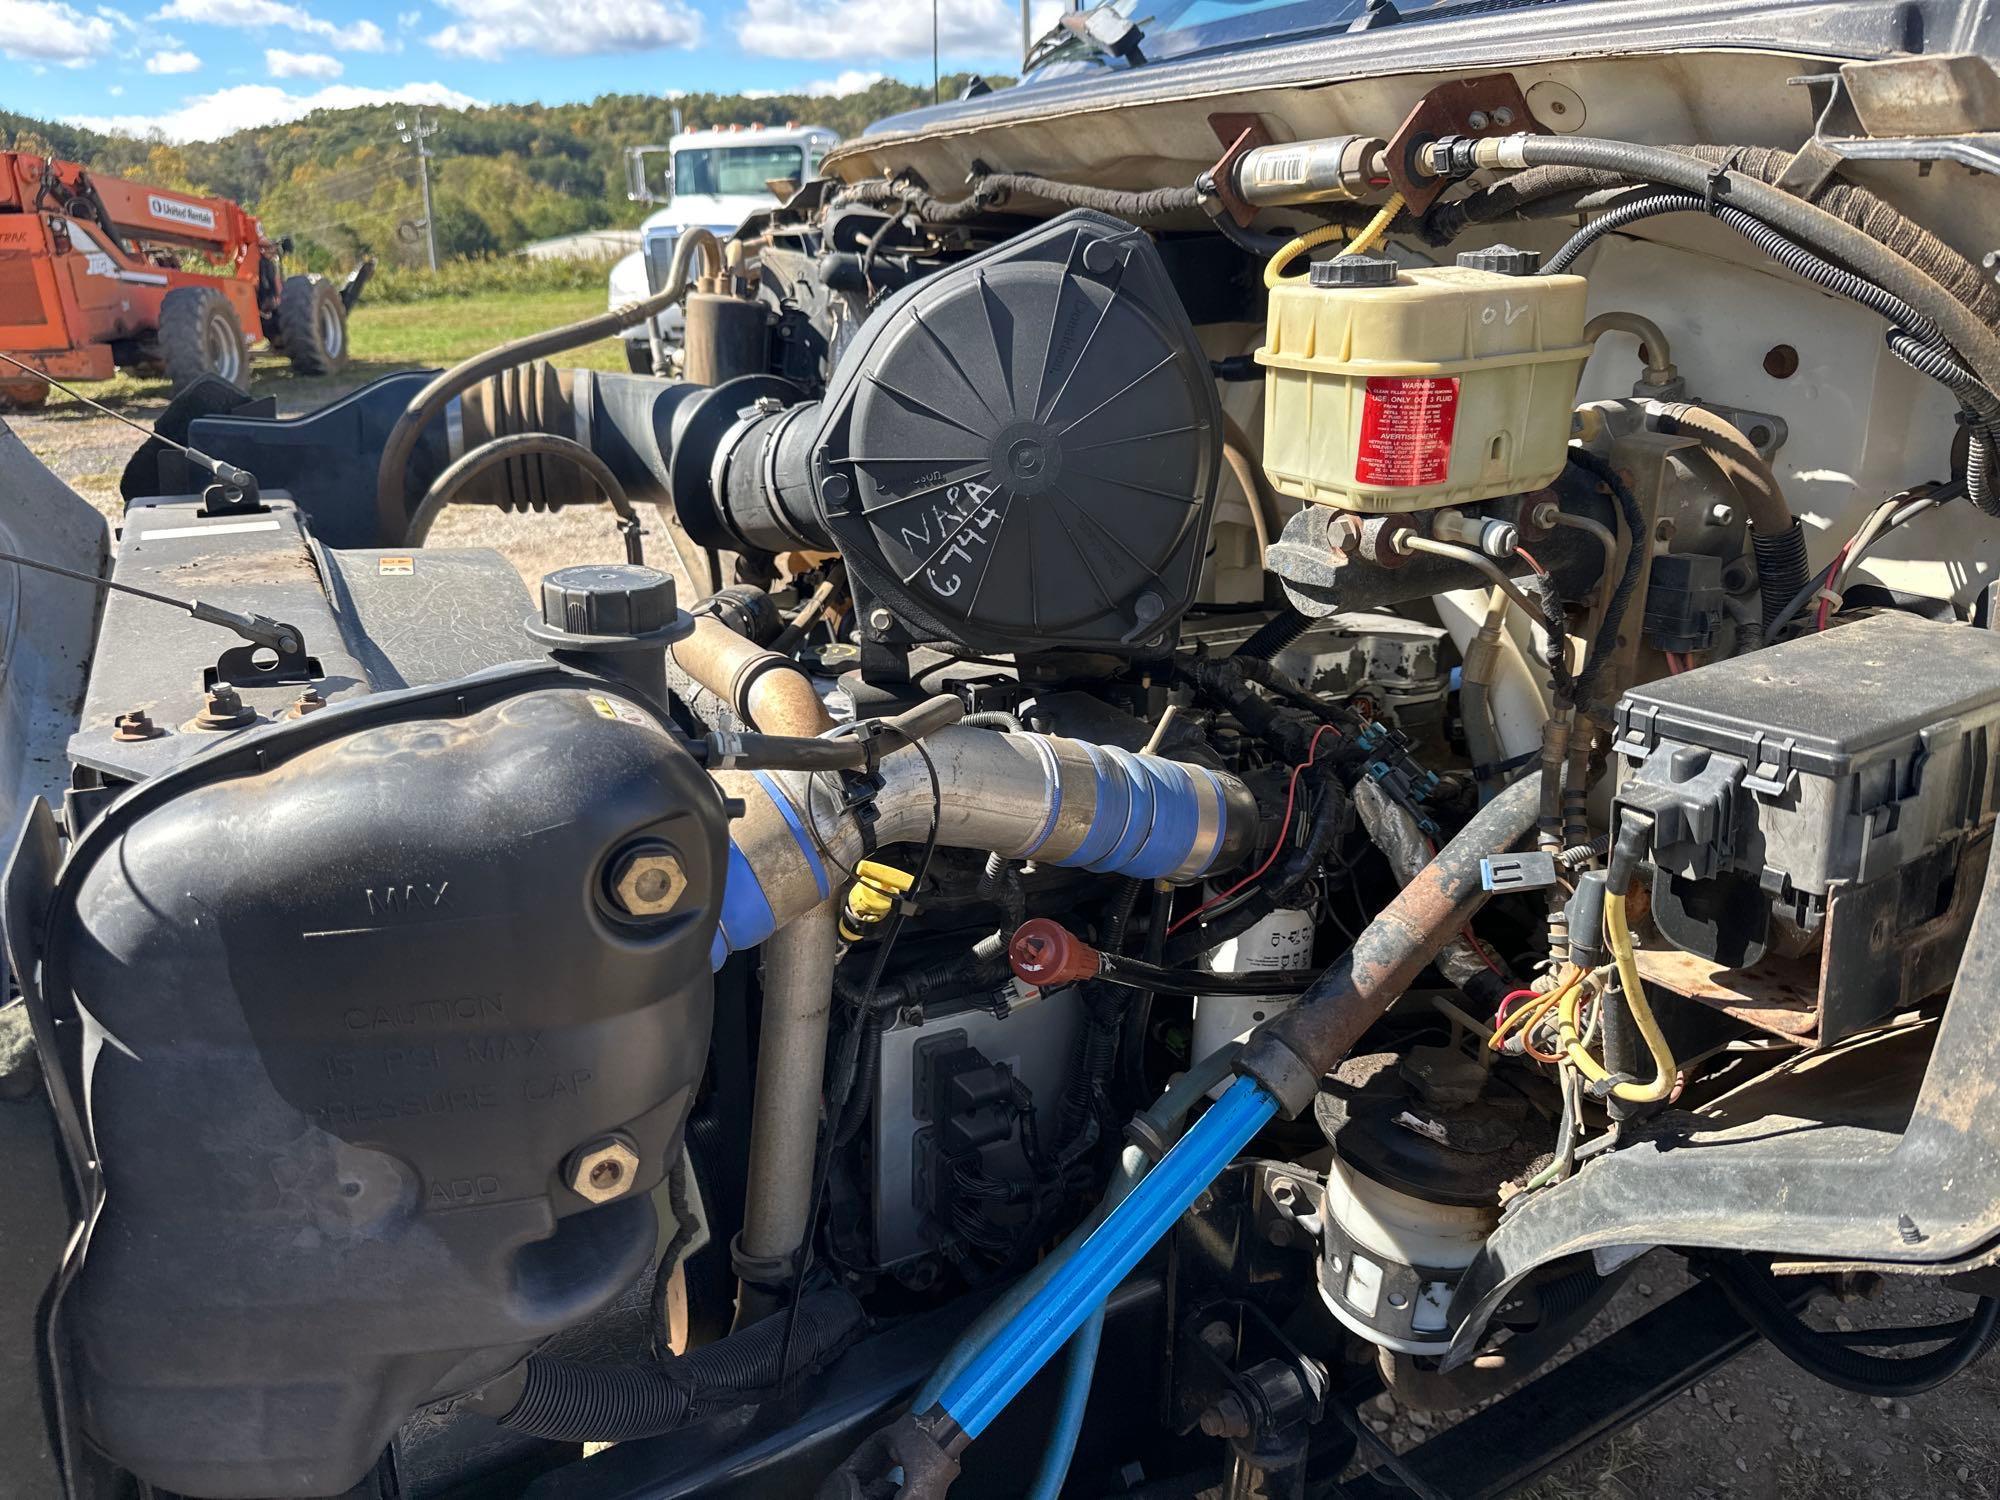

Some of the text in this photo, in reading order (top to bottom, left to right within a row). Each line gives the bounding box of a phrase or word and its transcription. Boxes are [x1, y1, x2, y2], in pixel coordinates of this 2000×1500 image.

[163, 202, 211, 224] United Rentals
[1380, 432, 1437, 440] AVERTISSEMENT
[900, 481, 992, 555] NAPA
[926, 506, 1002, 597] 6744
[365, 880, 456, 916] MAX
[343, 992, 510, 1033] CAUTION
[383, 1045, 441, 1080] PSI
[463, 1031, 547, 1065] MAX
[519, 1068, 594, 1104] CAP
[429, 1176, 501, 1202] ADD
